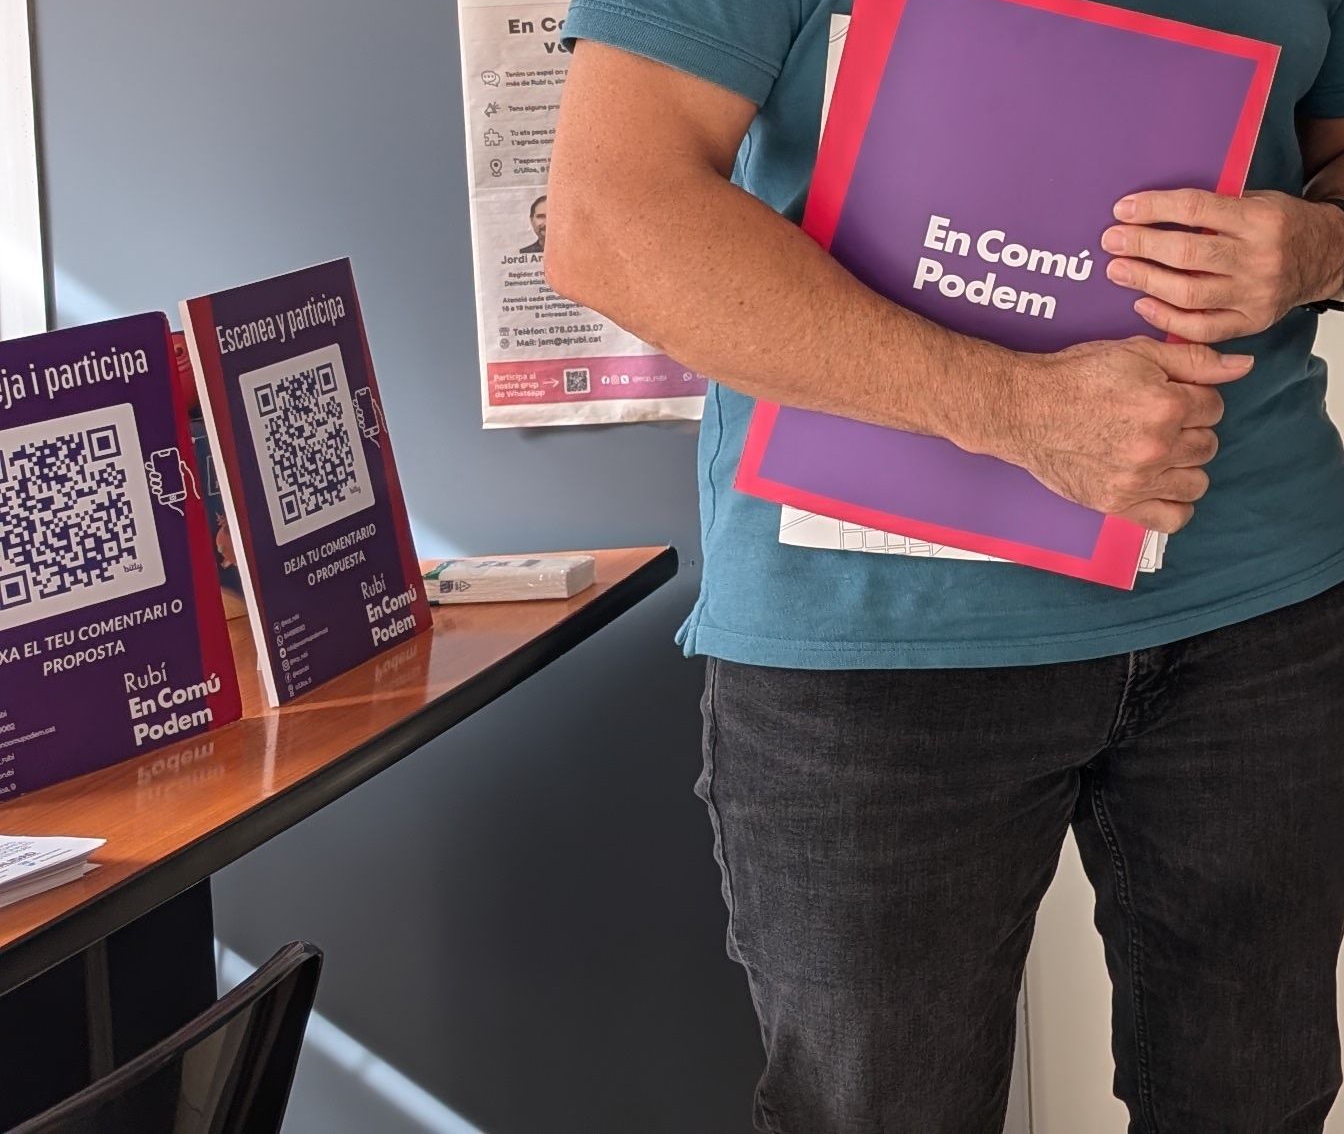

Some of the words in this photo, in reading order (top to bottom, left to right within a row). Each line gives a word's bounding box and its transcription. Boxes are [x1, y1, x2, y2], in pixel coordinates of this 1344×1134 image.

[508, 19, 534, 34] En
[501, 256, 528, 265] Jordi
[531, 254, 544, 263] Ar
[923, 214, 971, 257] En
[976, 229, 1094, 281] Comú
[912, 256, 1057, 320] Podem
[216, 314, 276, 354] Escanea
[276, 313, 286, 343] y
[286, 294, 345, 339] participa
[0, 368, 26, 409] ja
[30, 363, 40, 395] i
[44, 347, 149, 400] participa
[284, 554, 307, 575] DEJA
[306, 549, 320, 565] TU
[321, 523, 376, 558] COMENTARIO
[308, 572, 316, 586] O
[316, 550, 366, 583] PROPUESTA
[361, 573, 387, 600] Rubí
[366, 603, 383, 623] En
[383, 584, 417, 612] Comú
[24, 641, 42, 658] EL
[45, 630, 75, 651] TEU
[78, 602, 168, 641] COMENTARI
[171, 599, 183, 614] O
[371, 614, 416, 647] Podem
[43, 639, 126, 676] PROPOSTA
[124, 662, 168, 693] Rubí
[128, 697, 157, 720] En
[158, 673, 221, 709] Comú
[133, 707, 213, 746] Podem
